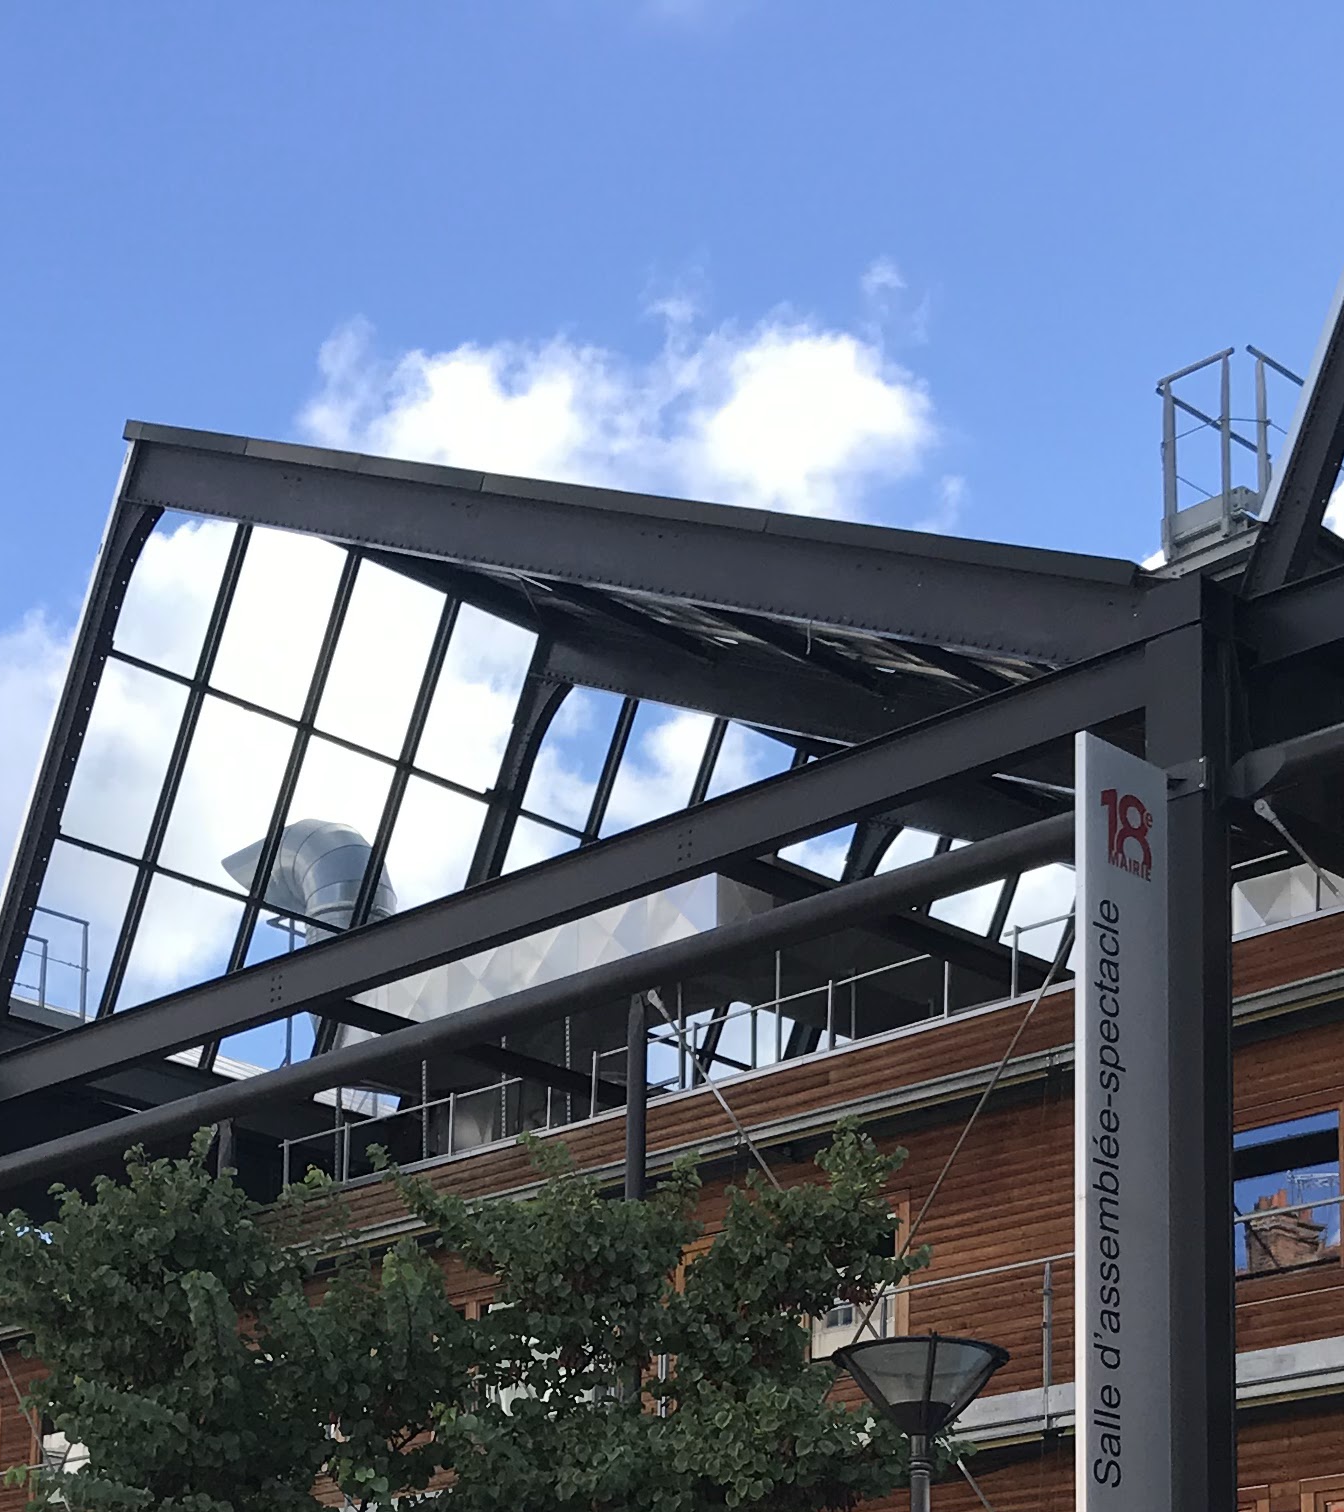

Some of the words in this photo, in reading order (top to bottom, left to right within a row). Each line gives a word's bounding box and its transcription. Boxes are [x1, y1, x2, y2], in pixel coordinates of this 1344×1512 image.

[1108, 850, 1152, 882] MAIRIE
[1092, 898, 1127, 1370] d'assemblée-spectacle
[1093, 1384, 1122, 1489] Salle
